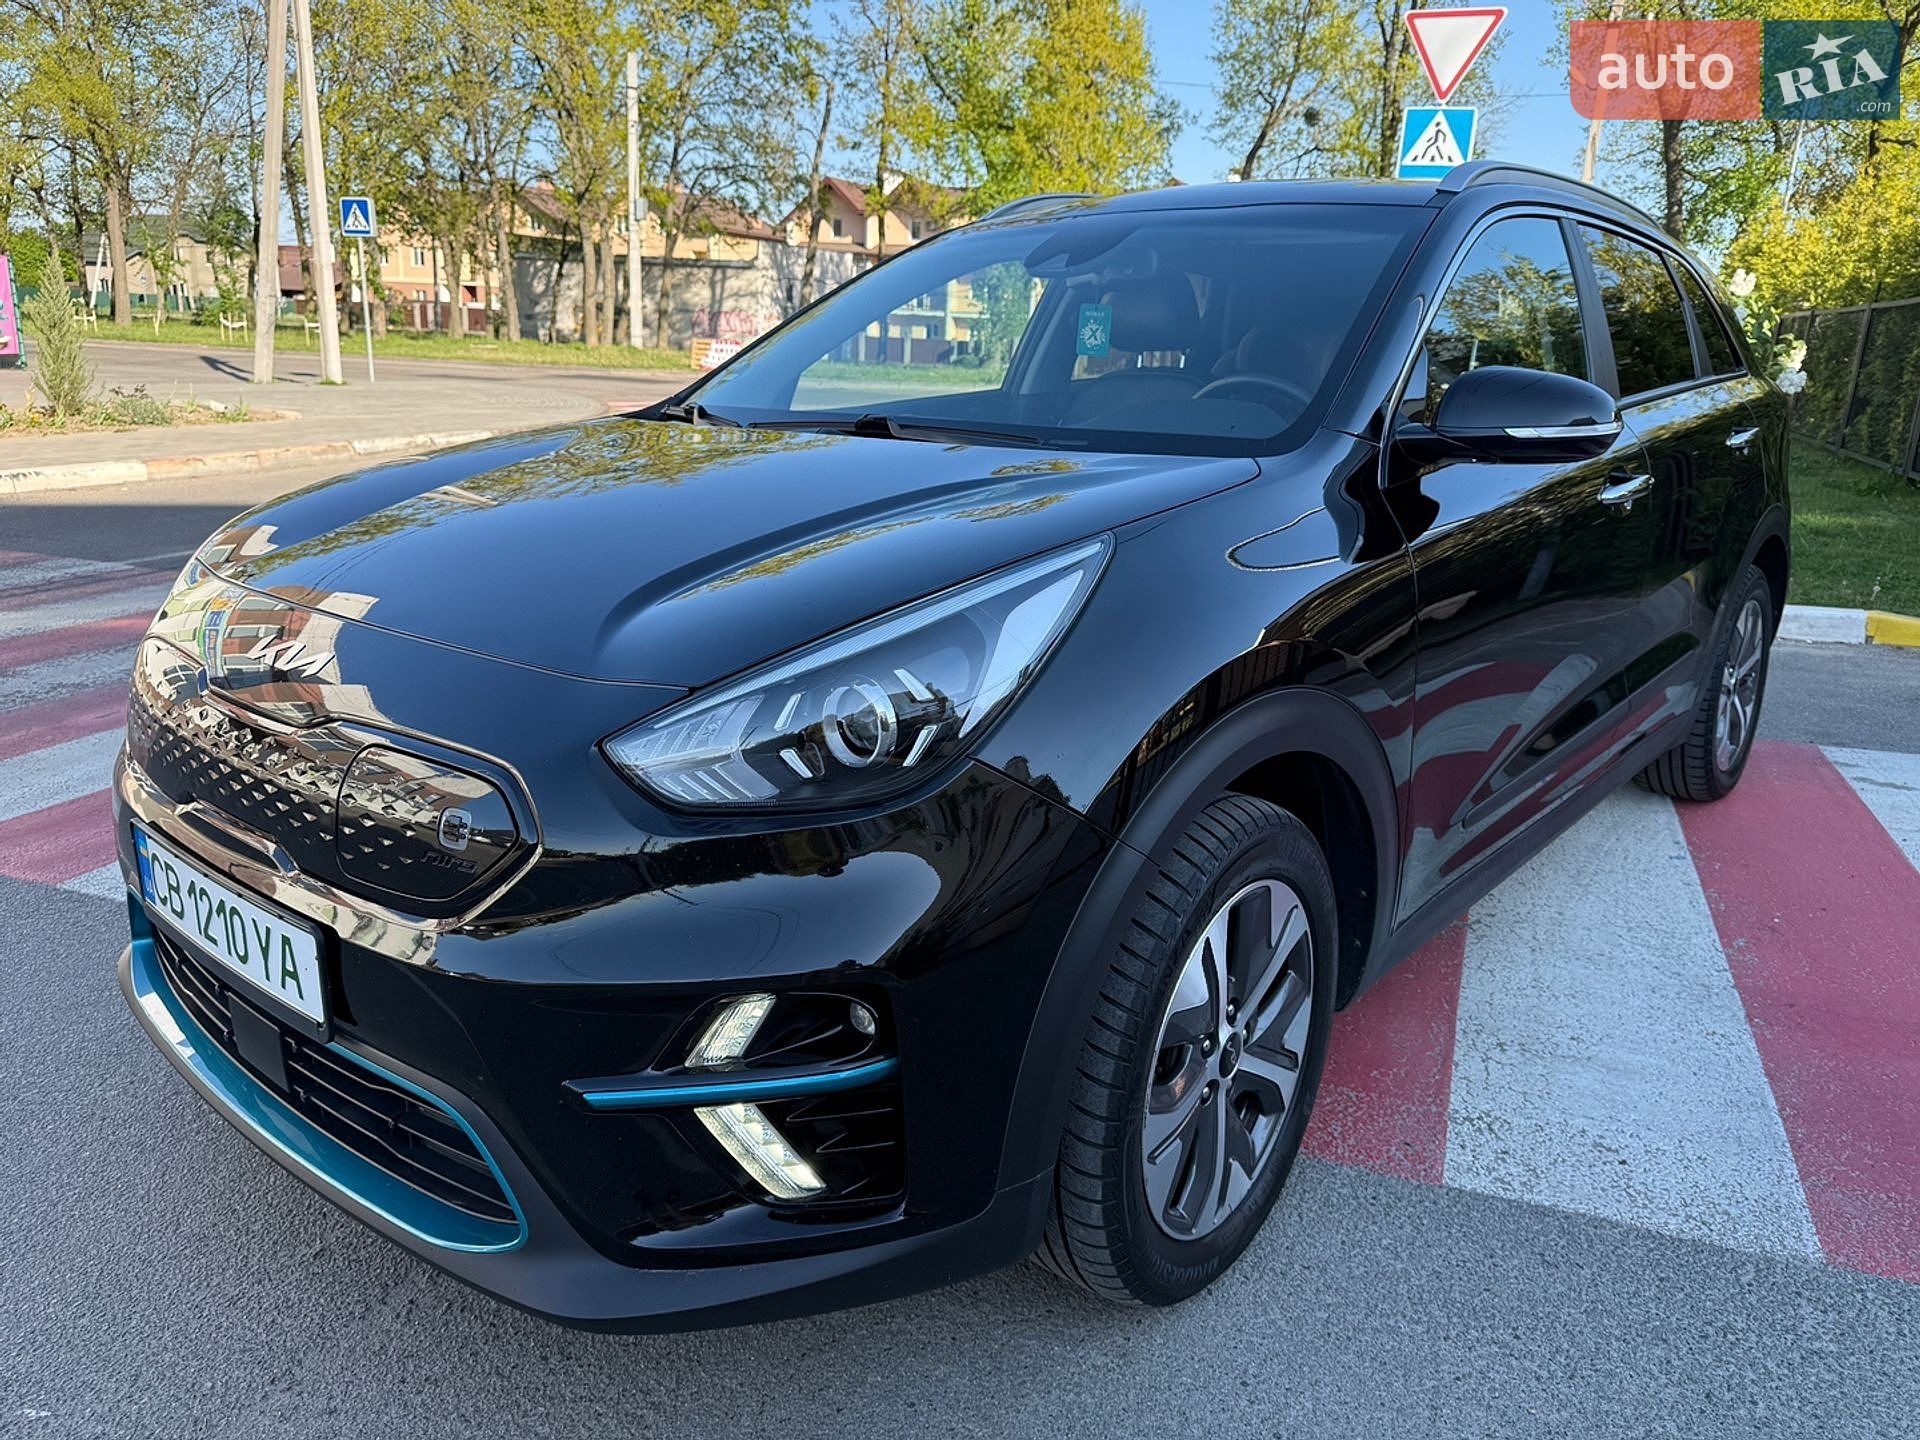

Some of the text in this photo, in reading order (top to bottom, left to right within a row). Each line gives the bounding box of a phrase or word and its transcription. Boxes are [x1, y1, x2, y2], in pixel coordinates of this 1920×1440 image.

[151, 852, 304, 1001] CB 1210 YA
